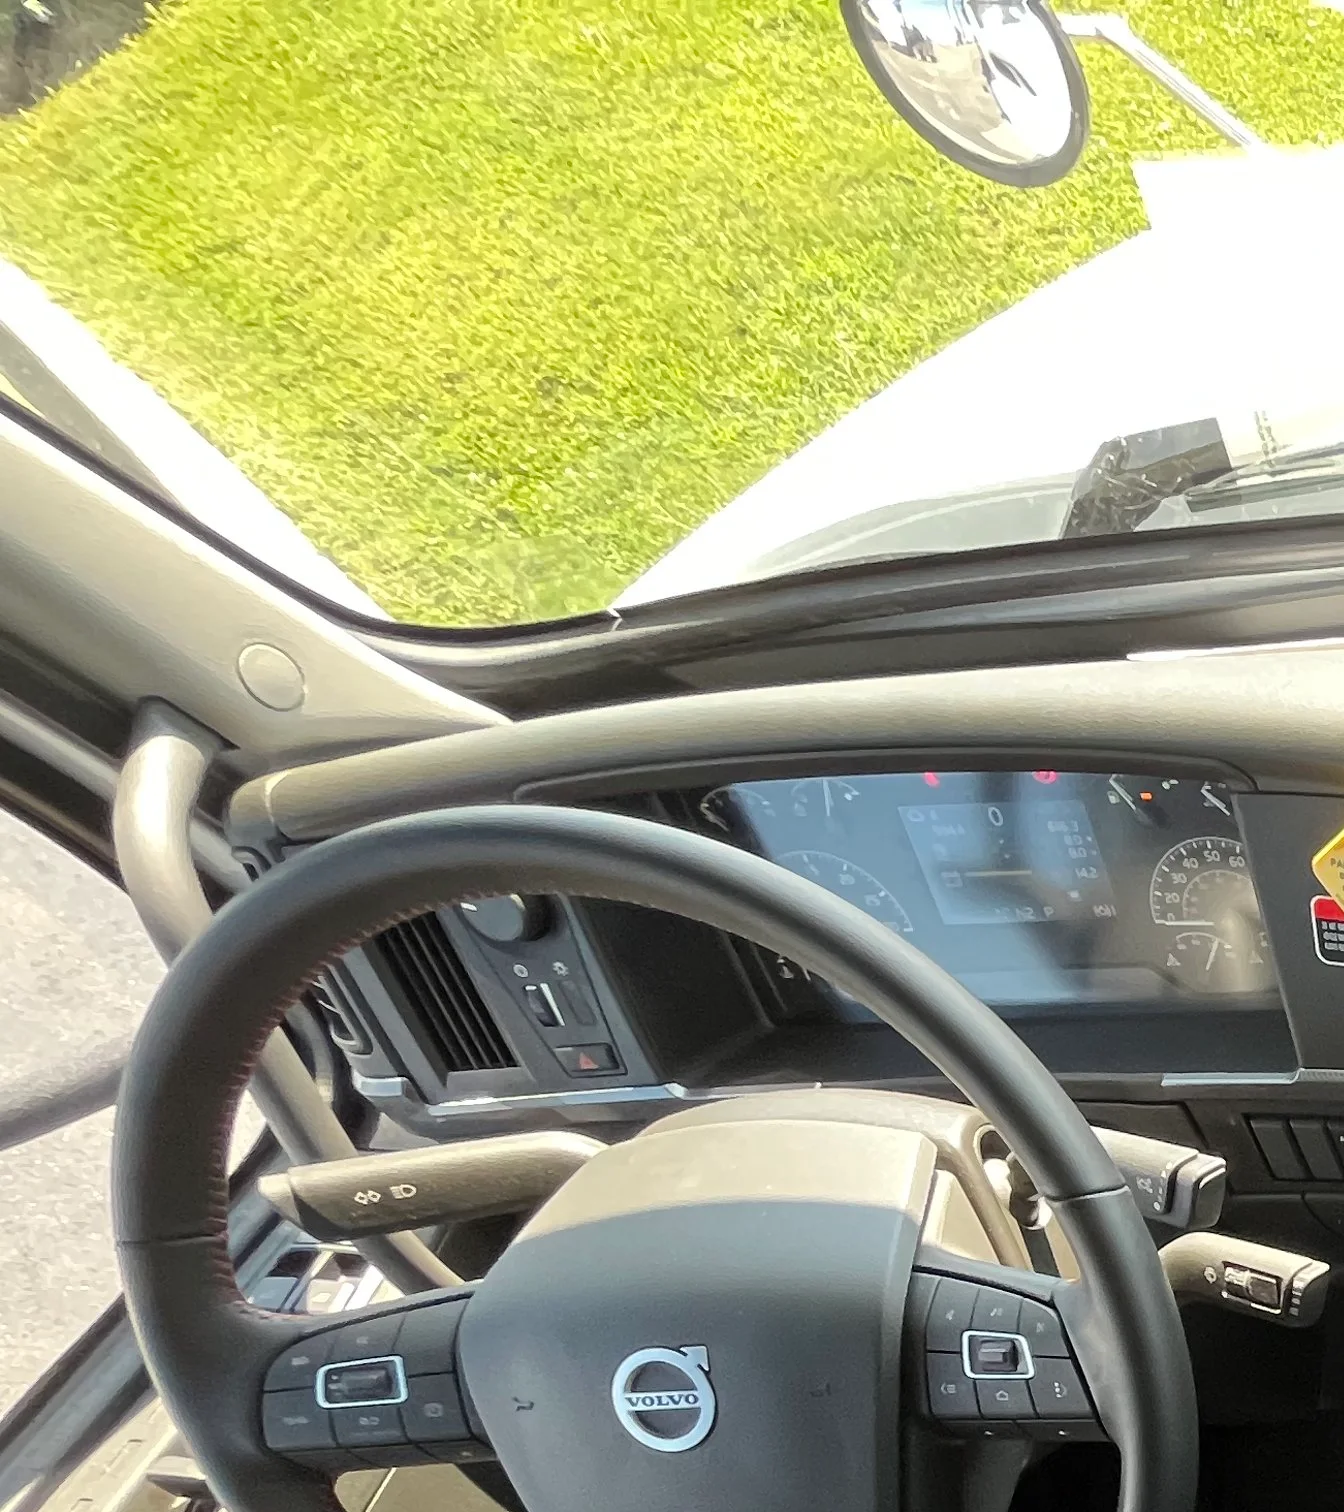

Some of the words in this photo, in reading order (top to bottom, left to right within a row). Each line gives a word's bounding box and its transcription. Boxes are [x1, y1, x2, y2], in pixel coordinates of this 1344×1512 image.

[1203, 850, 1220, 862] 50
[1228, 855, 1245, 868] 60
[1182, 857, 1199, 869] 40
[1171, 872, 1187, 884] 30
[1163, 892, 1180, 904] 20
[625, 1393, 699, 1407] VOLVO
